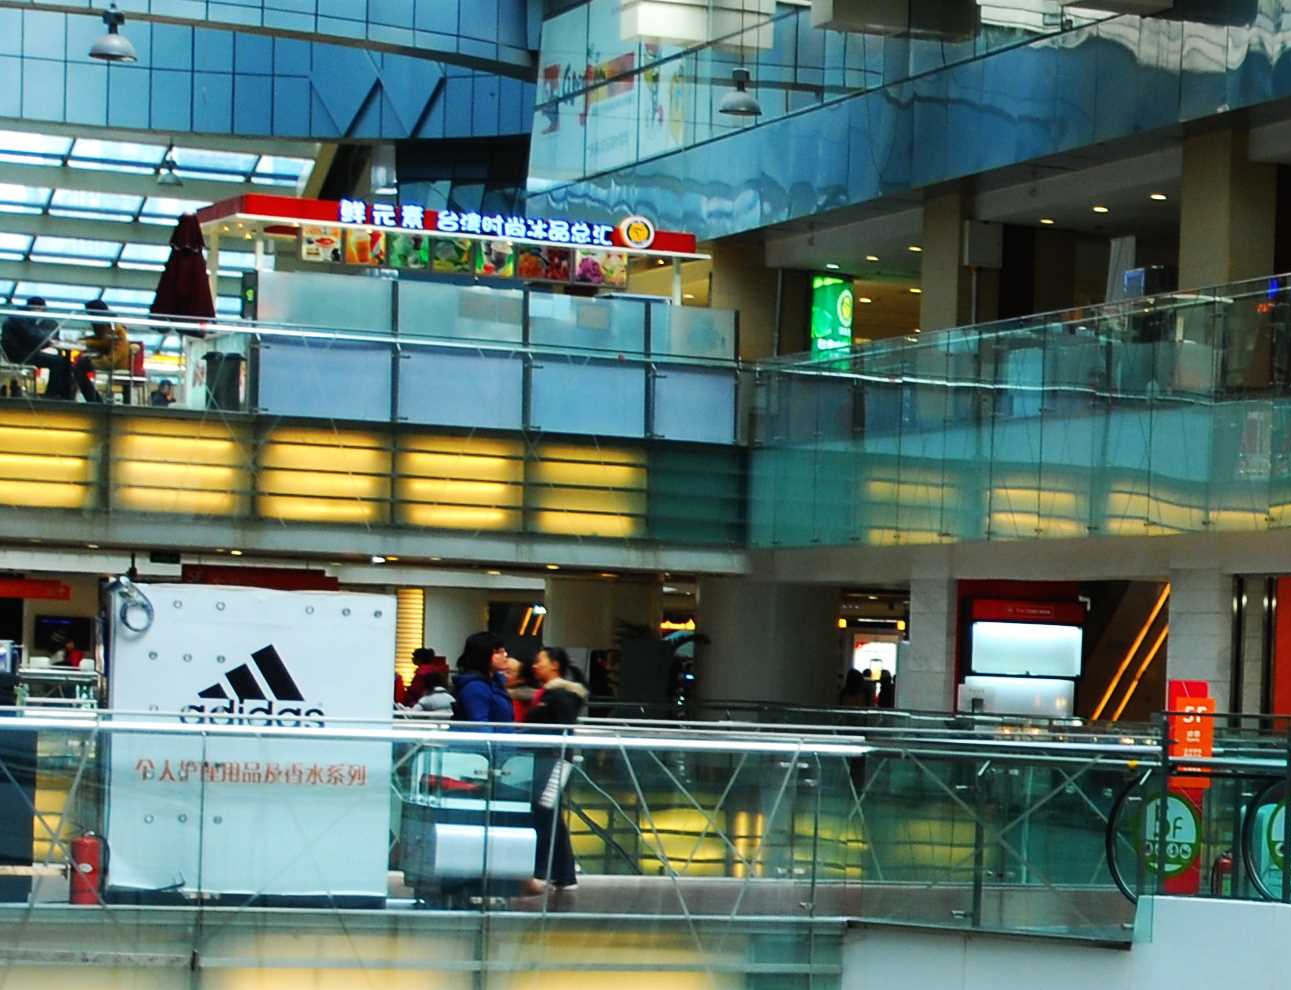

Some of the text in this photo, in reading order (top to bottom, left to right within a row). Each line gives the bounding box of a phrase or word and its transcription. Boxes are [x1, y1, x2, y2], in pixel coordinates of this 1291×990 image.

[340, 199, 614, 246] 鲜元素 台湾时尚冰品总汇
[179, 699, 325, 729] adidas
